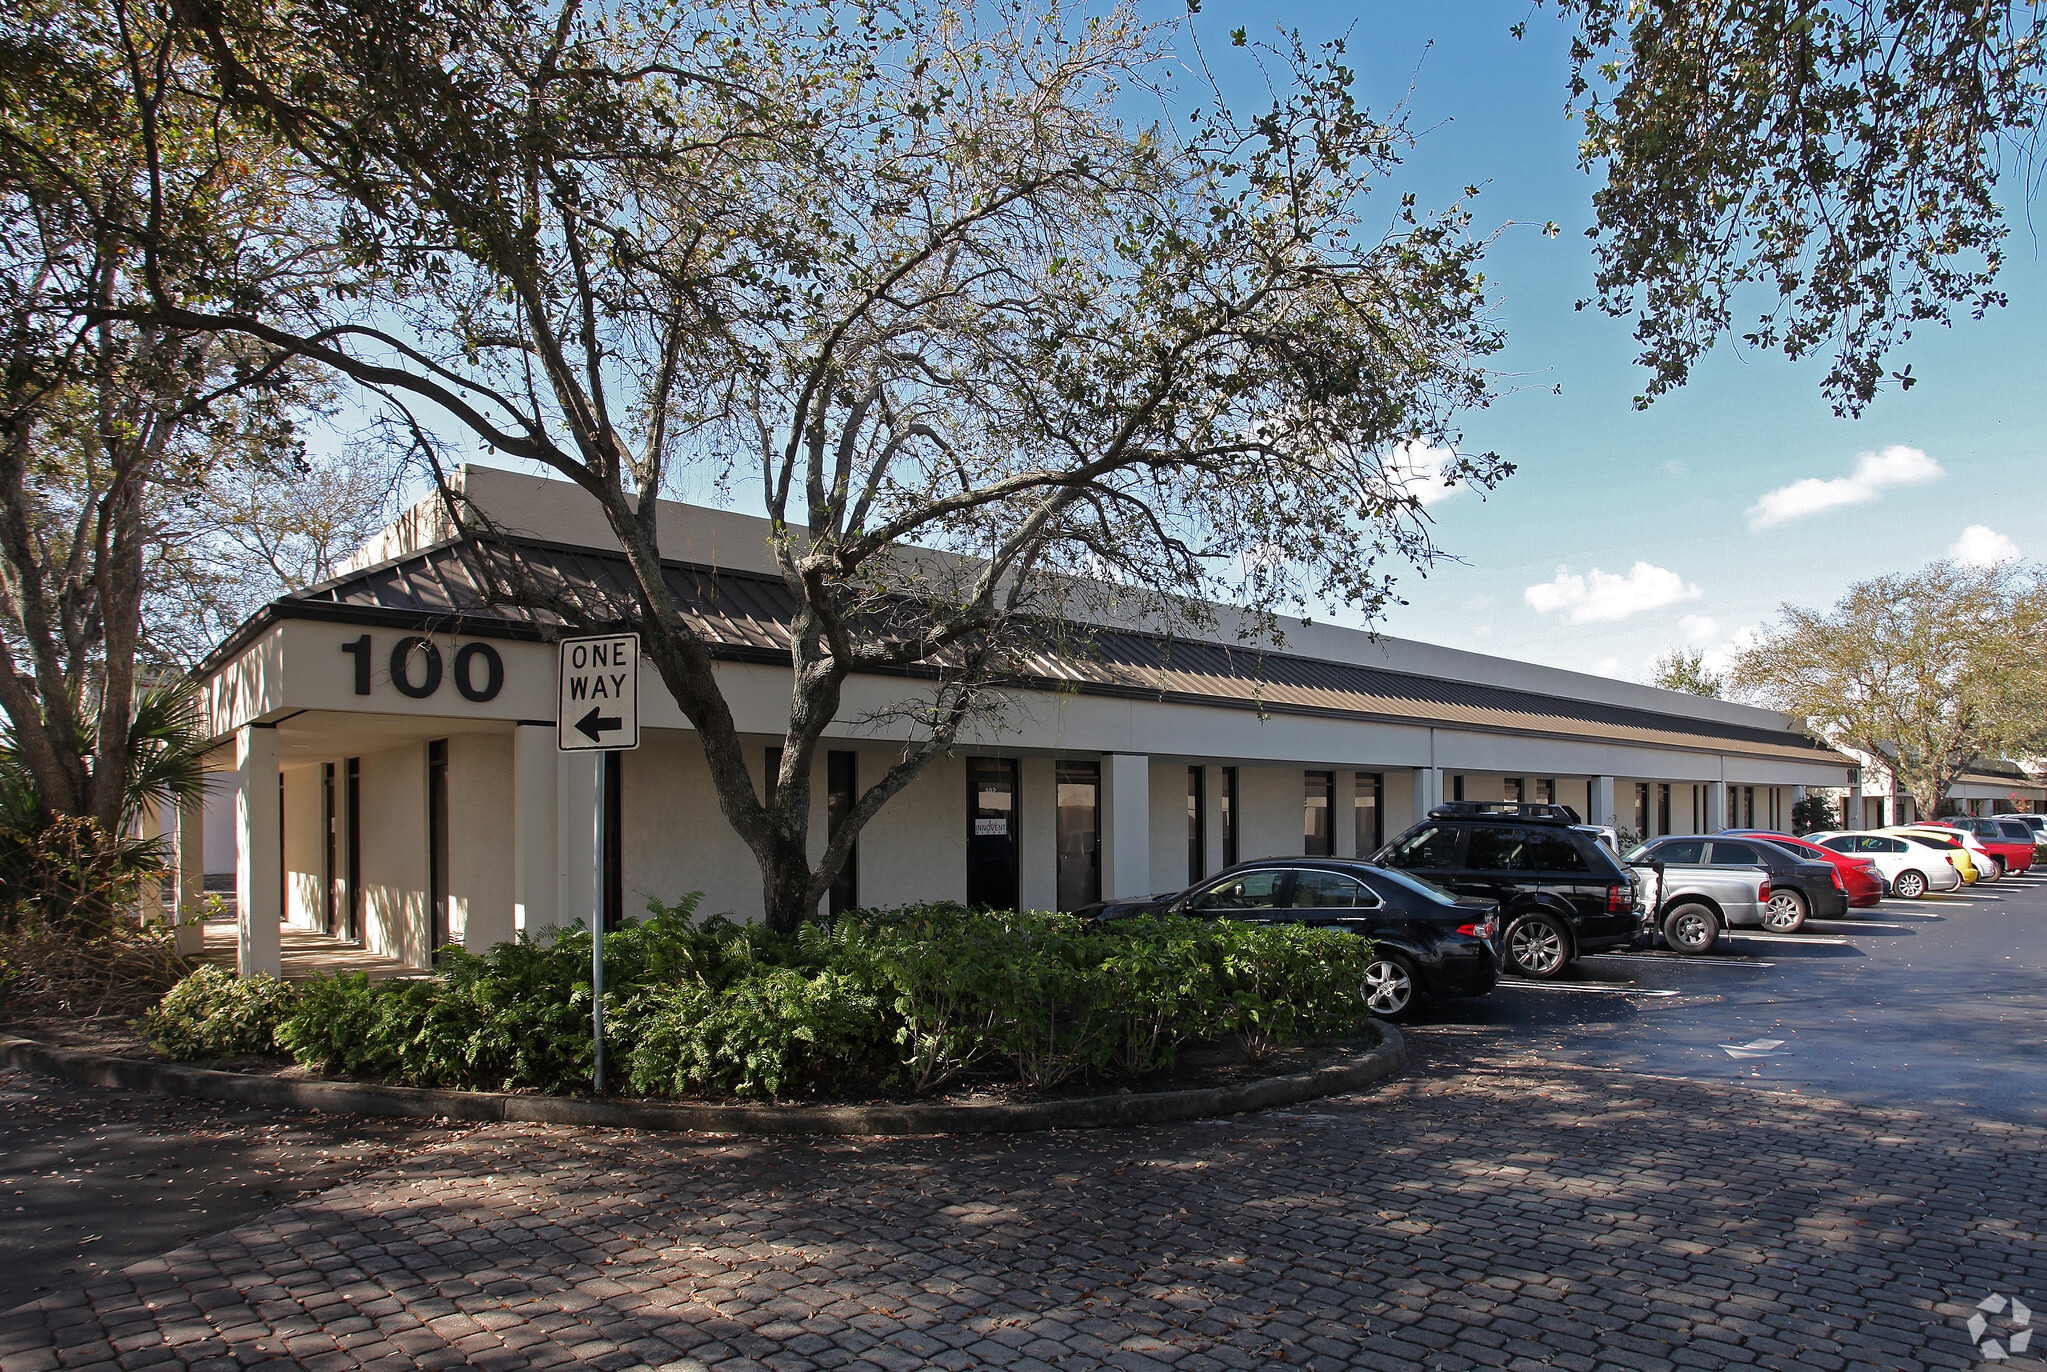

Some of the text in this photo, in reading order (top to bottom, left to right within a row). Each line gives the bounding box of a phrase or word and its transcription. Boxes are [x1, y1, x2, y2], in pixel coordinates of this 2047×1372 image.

[342, 634, 504, 702] 100
[572, 642, 627, 669] ONE
[570, 673, 627, 701] WAY
[1847, 768, 1858, 784] 100
